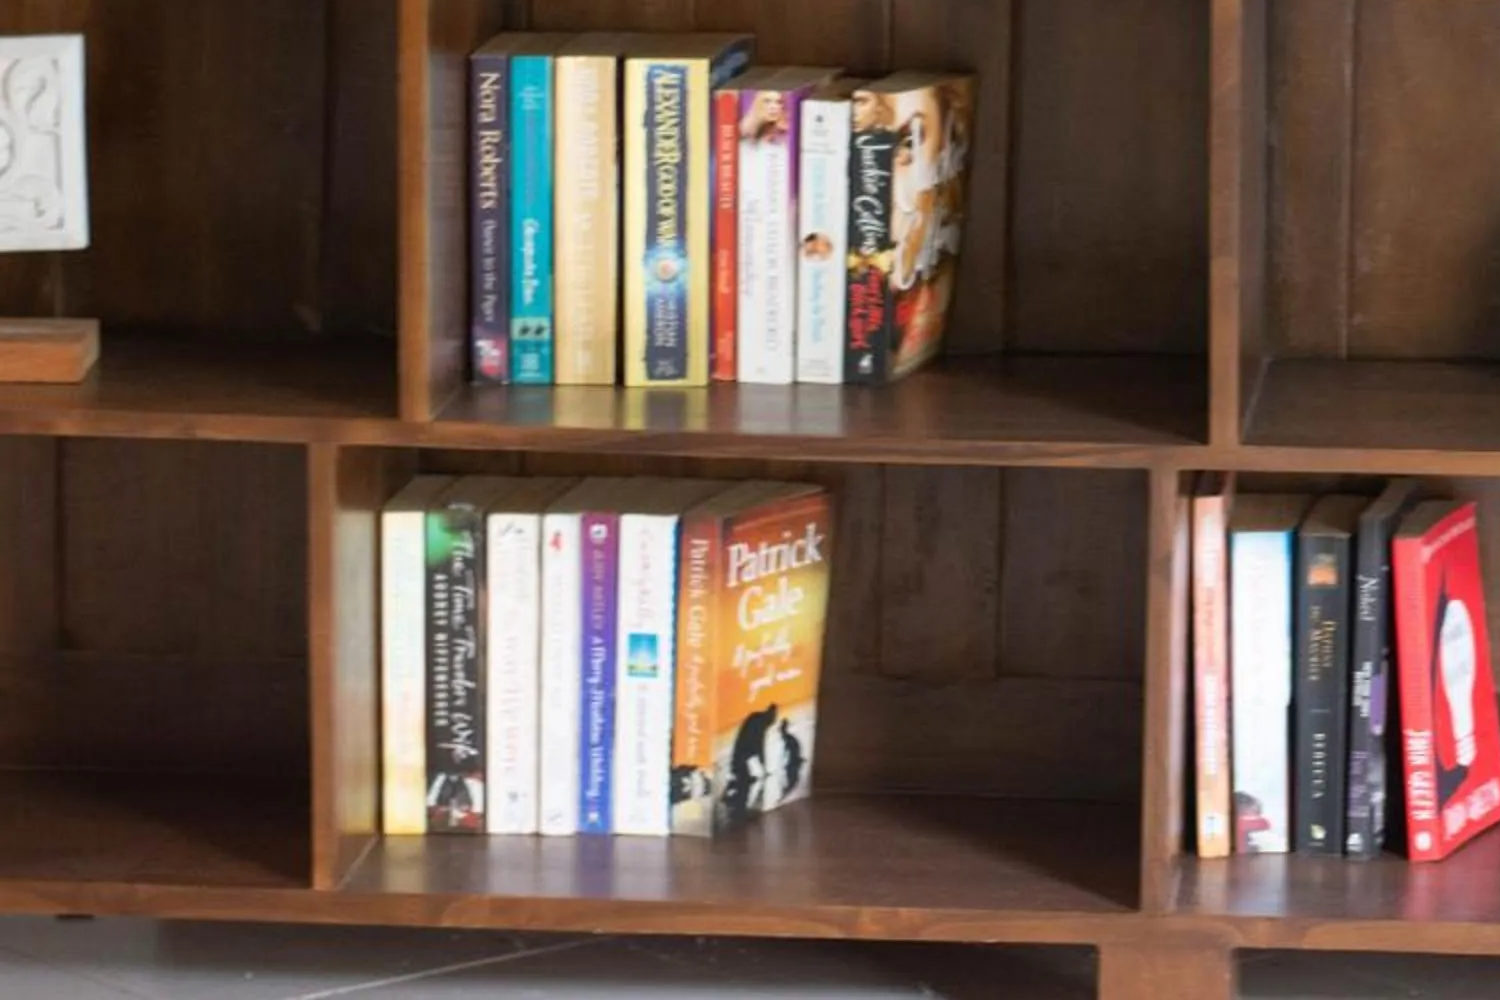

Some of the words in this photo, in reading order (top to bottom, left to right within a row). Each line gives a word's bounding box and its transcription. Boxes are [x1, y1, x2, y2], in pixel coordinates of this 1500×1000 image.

[478, 72, 501, 123] Nora
[653, 69, 682, 164] ALEXANDER
[478, 130, 502, 209] Roberts
[655, 166, 678, 197] GOD
[856, 135, 892, 195] Jackie
[853, 196, 890, 256] Collins
[451, 530, 475, 576] The
[687, 538, 710, 599] Patrick
[727, 522, 826, 588] Patrick
[433, 573, 449, 626] AUDREY
[451, 571, 476, 627] Time
[687, 605, 706, 648] Gale
[738, 576, 804, 632] Gale
[436, 712, 480, 765] Wife
[1311, 733, 1326, 799] REBECCA
[1404, 729, 1432, 766] JOHN
[1409, 770, 1435, 820] GREEN
